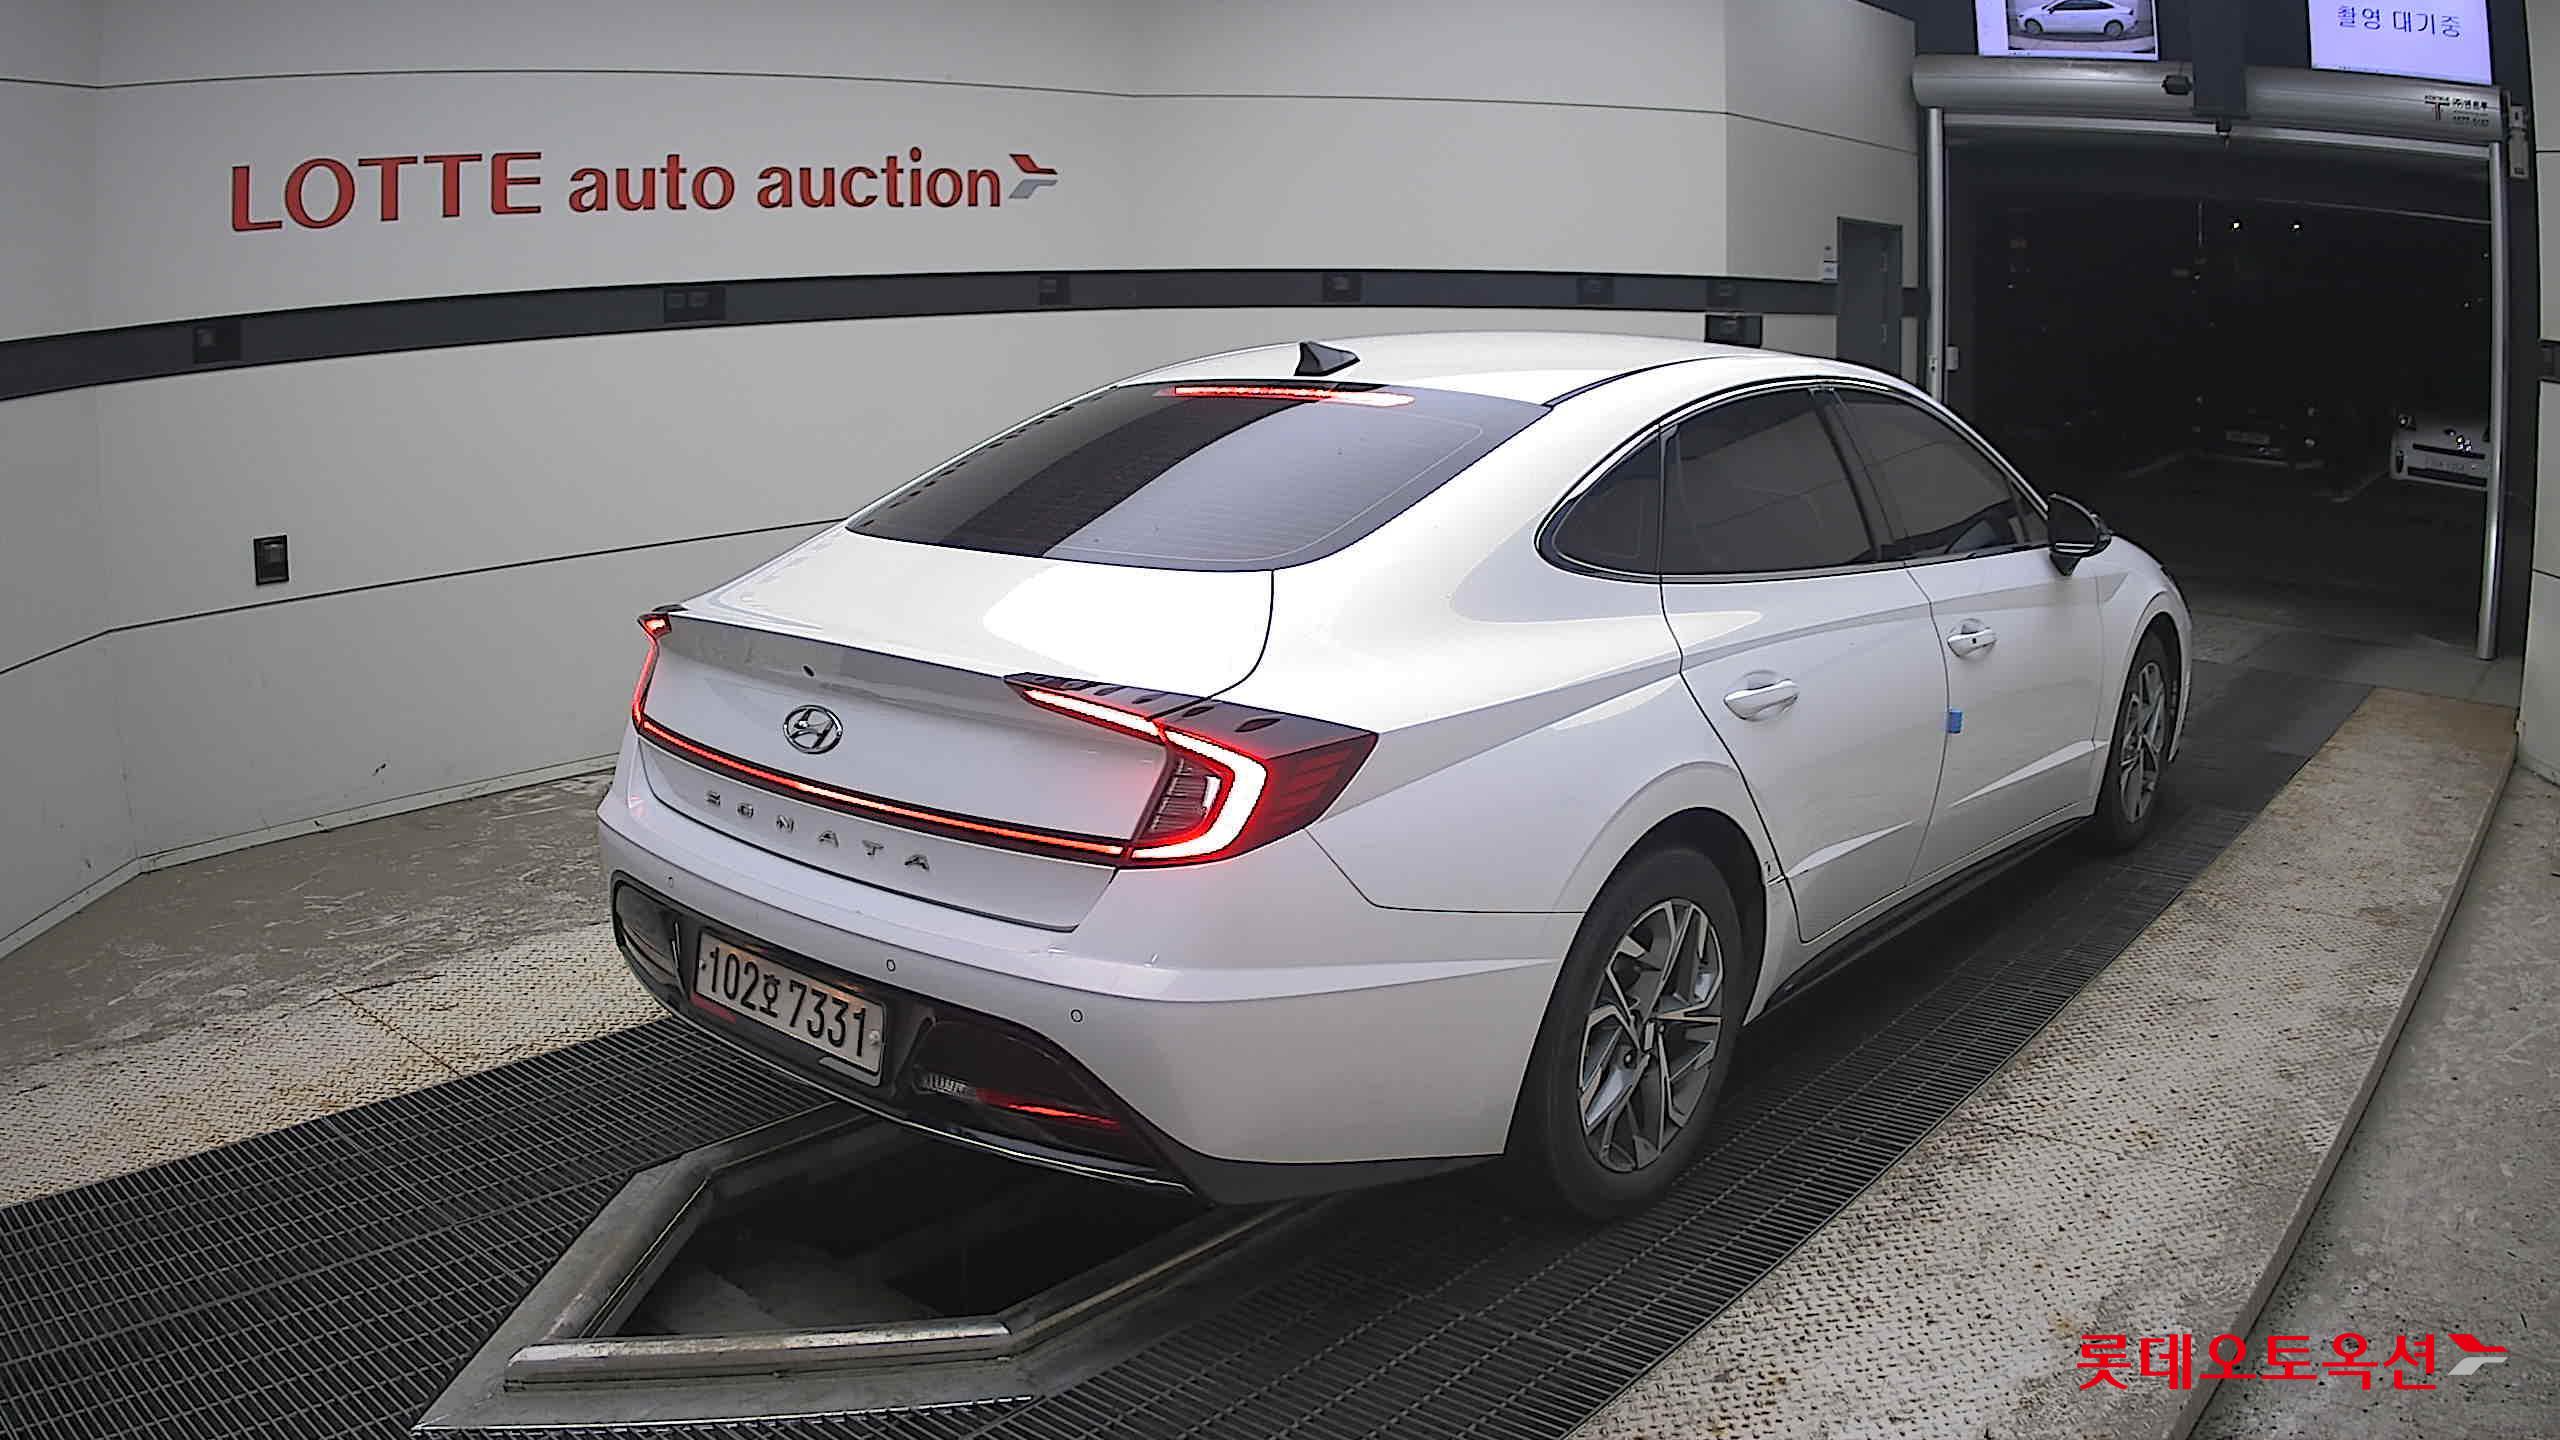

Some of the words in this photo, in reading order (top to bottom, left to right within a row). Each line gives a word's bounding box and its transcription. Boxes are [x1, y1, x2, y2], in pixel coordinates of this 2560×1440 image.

[2392, 10, 2461, 38] 대기중
[231, 151, 542, 232] LOTTE
[568, 153, 736, 213] auto
[756, 147, 1002, 208] auction
[706, 791, 931, 872] SONATA
